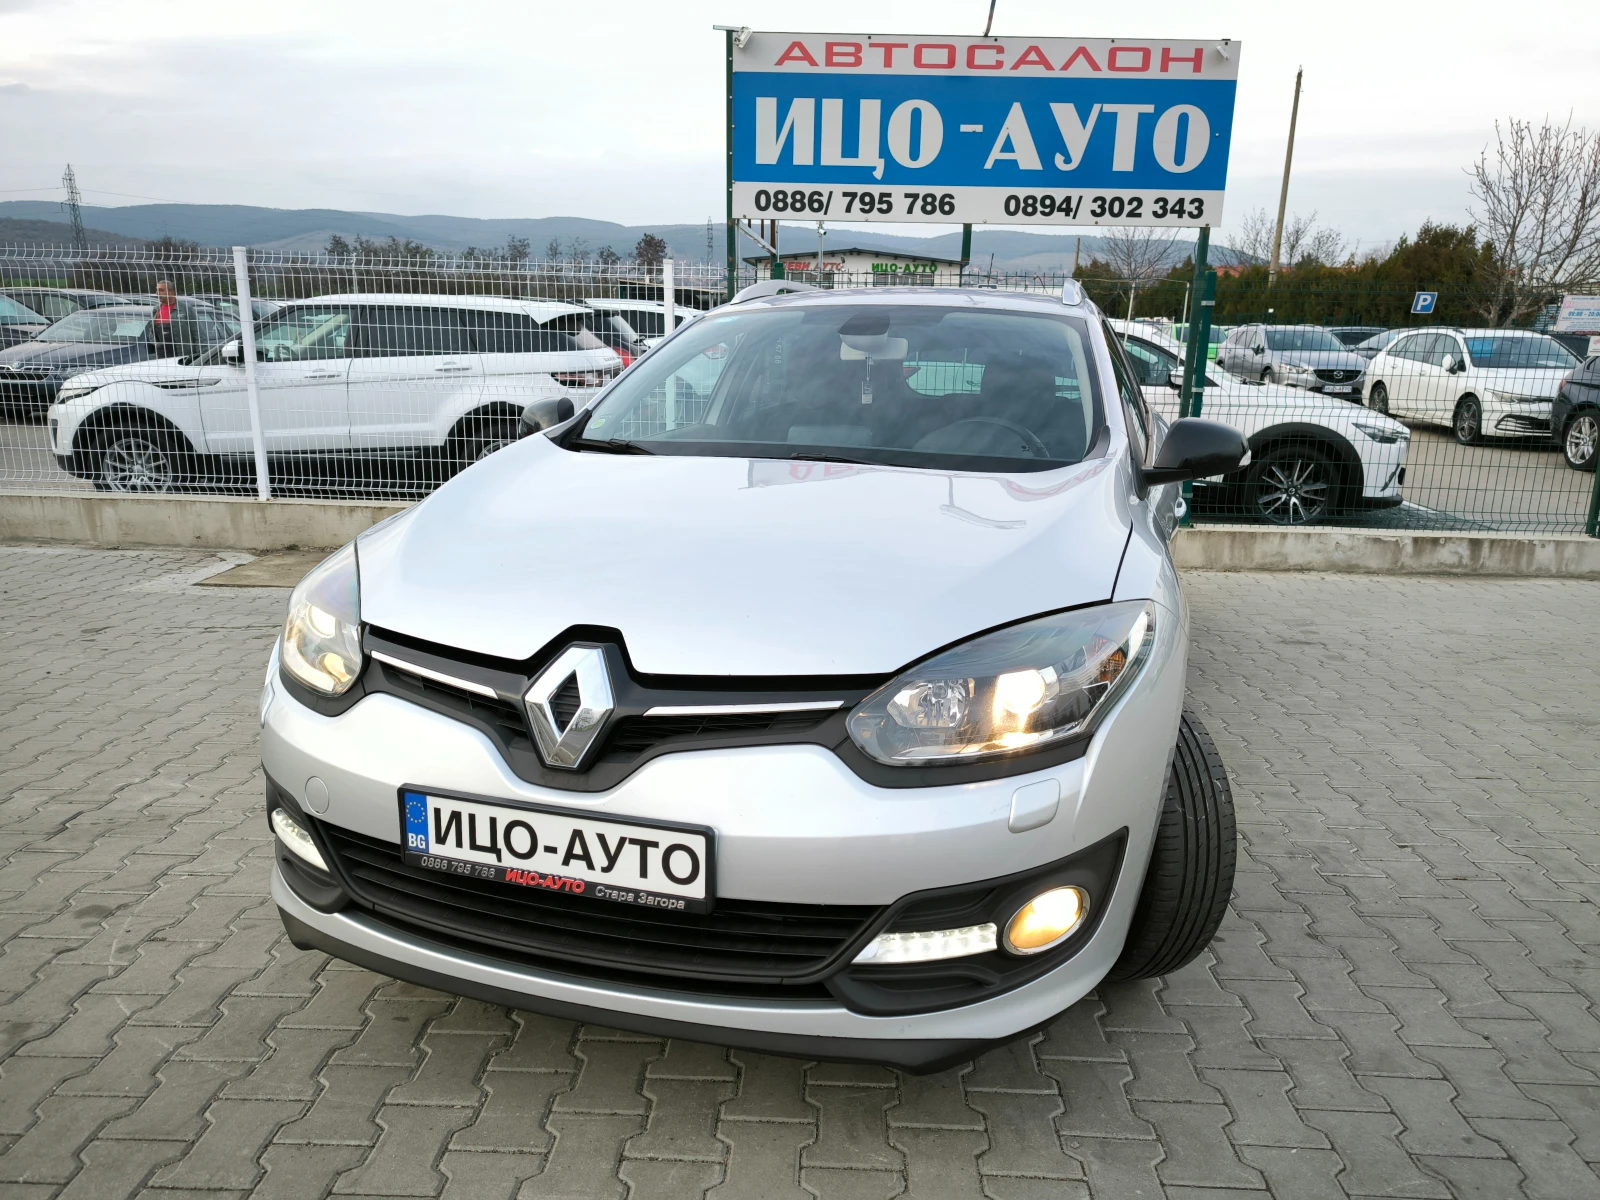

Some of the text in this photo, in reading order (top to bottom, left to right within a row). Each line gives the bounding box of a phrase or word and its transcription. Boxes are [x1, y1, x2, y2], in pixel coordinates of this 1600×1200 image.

[774, 41, 1204, 74] АВТОСАЛОН
[754, 189, 955, 215] 0886/ 795 786
[1003, 194, 1205, 219] 0894/ 302 343
[871, 263, 938, 273] ИЦО-АУТО
[1416, 294, 1432, 311] P
[408, 832, 426, 849] BG
[433, 806, 700, 886] ИЦО-АУТО
[421, 856, 686, 910] 0886 795 786 ИЦО-АУТО Стара Загора
